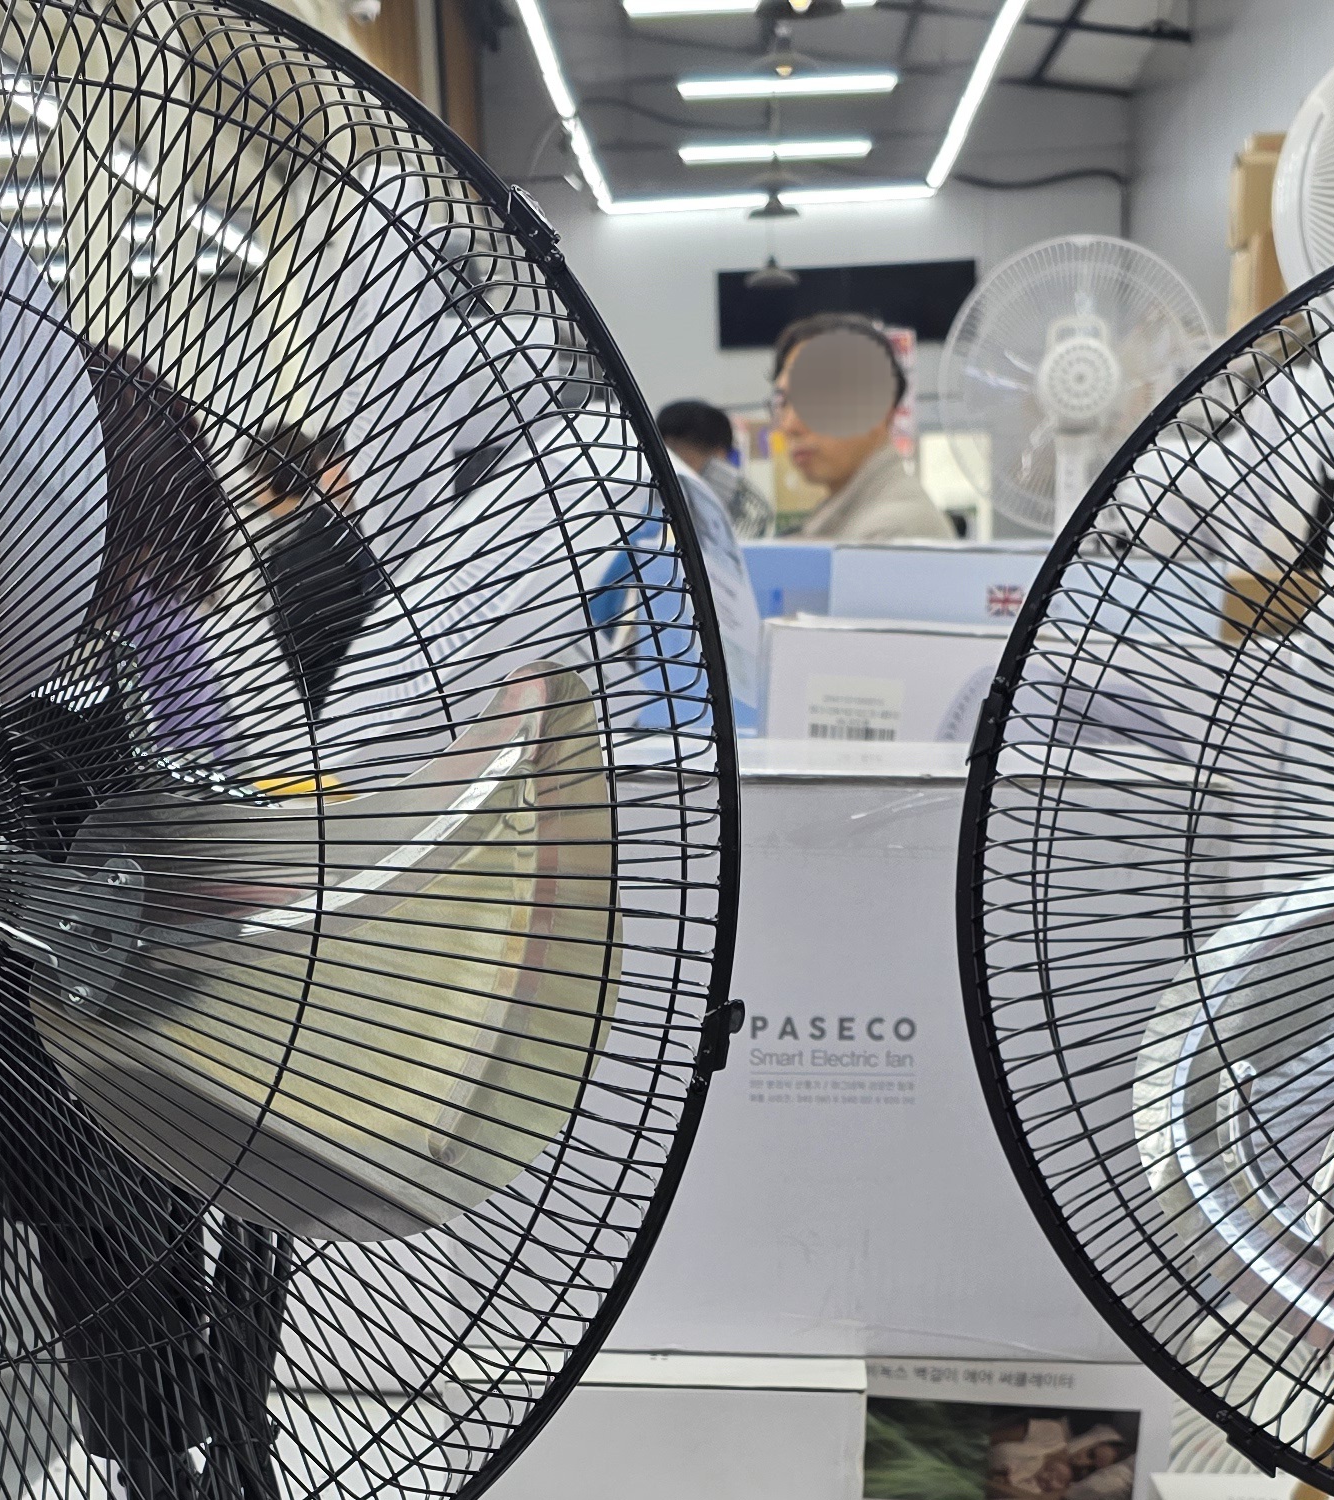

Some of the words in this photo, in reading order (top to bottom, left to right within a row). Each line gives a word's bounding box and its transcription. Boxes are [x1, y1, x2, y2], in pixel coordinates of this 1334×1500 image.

[749, 1016, 918, 1042] PASECO
[749, 1048, 804, 1067] Smart
[810, 1049, 879, 1068] Electric
[885, 1050, 915, 1069] fan
